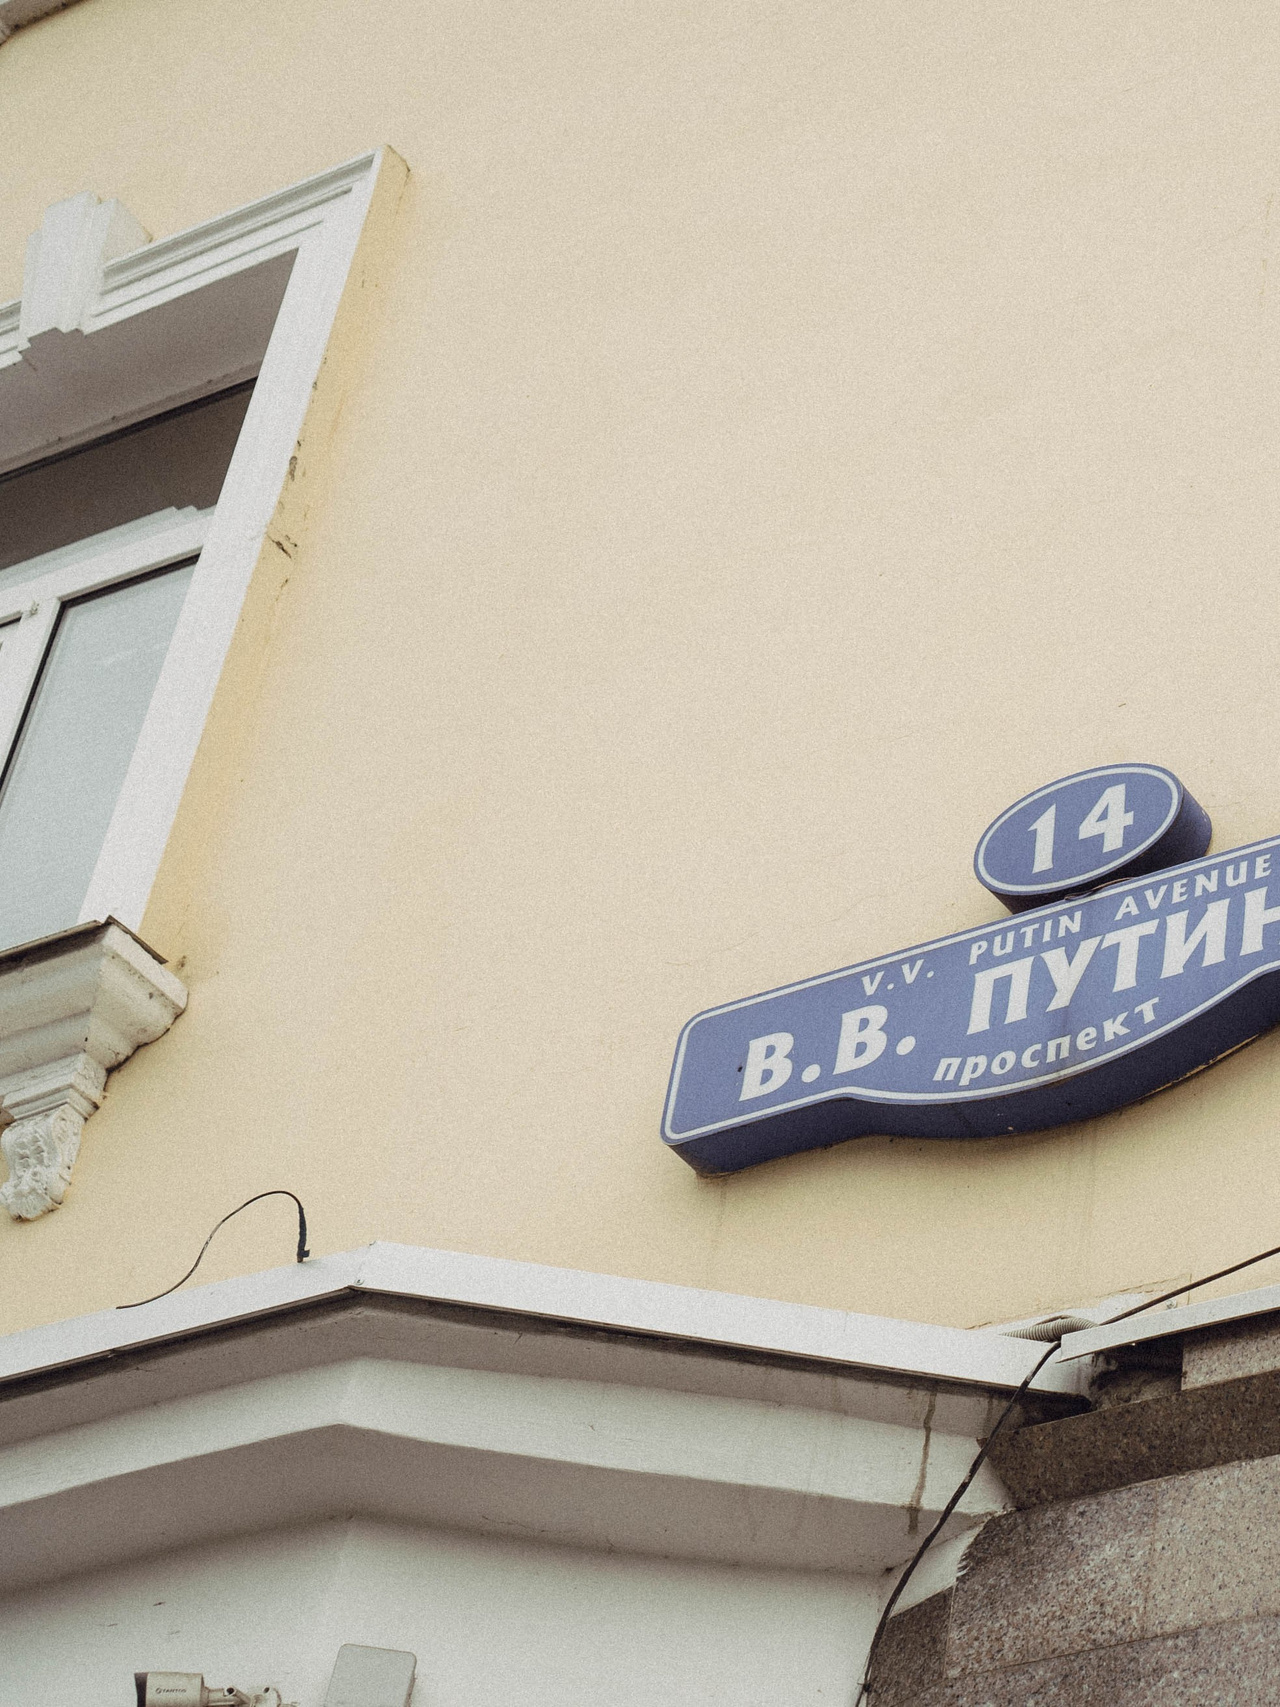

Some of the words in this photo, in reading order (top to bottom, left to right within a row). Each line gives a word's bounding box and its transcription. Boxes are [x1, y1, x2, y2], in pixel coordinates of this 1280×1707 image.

[1028, 783, 1135, 874] 14
[968, 910, 1083, 966] PUTIN
[1114, 853, 1272, 921] AVENUE
[932, 996, 1160, 1087] проспект
